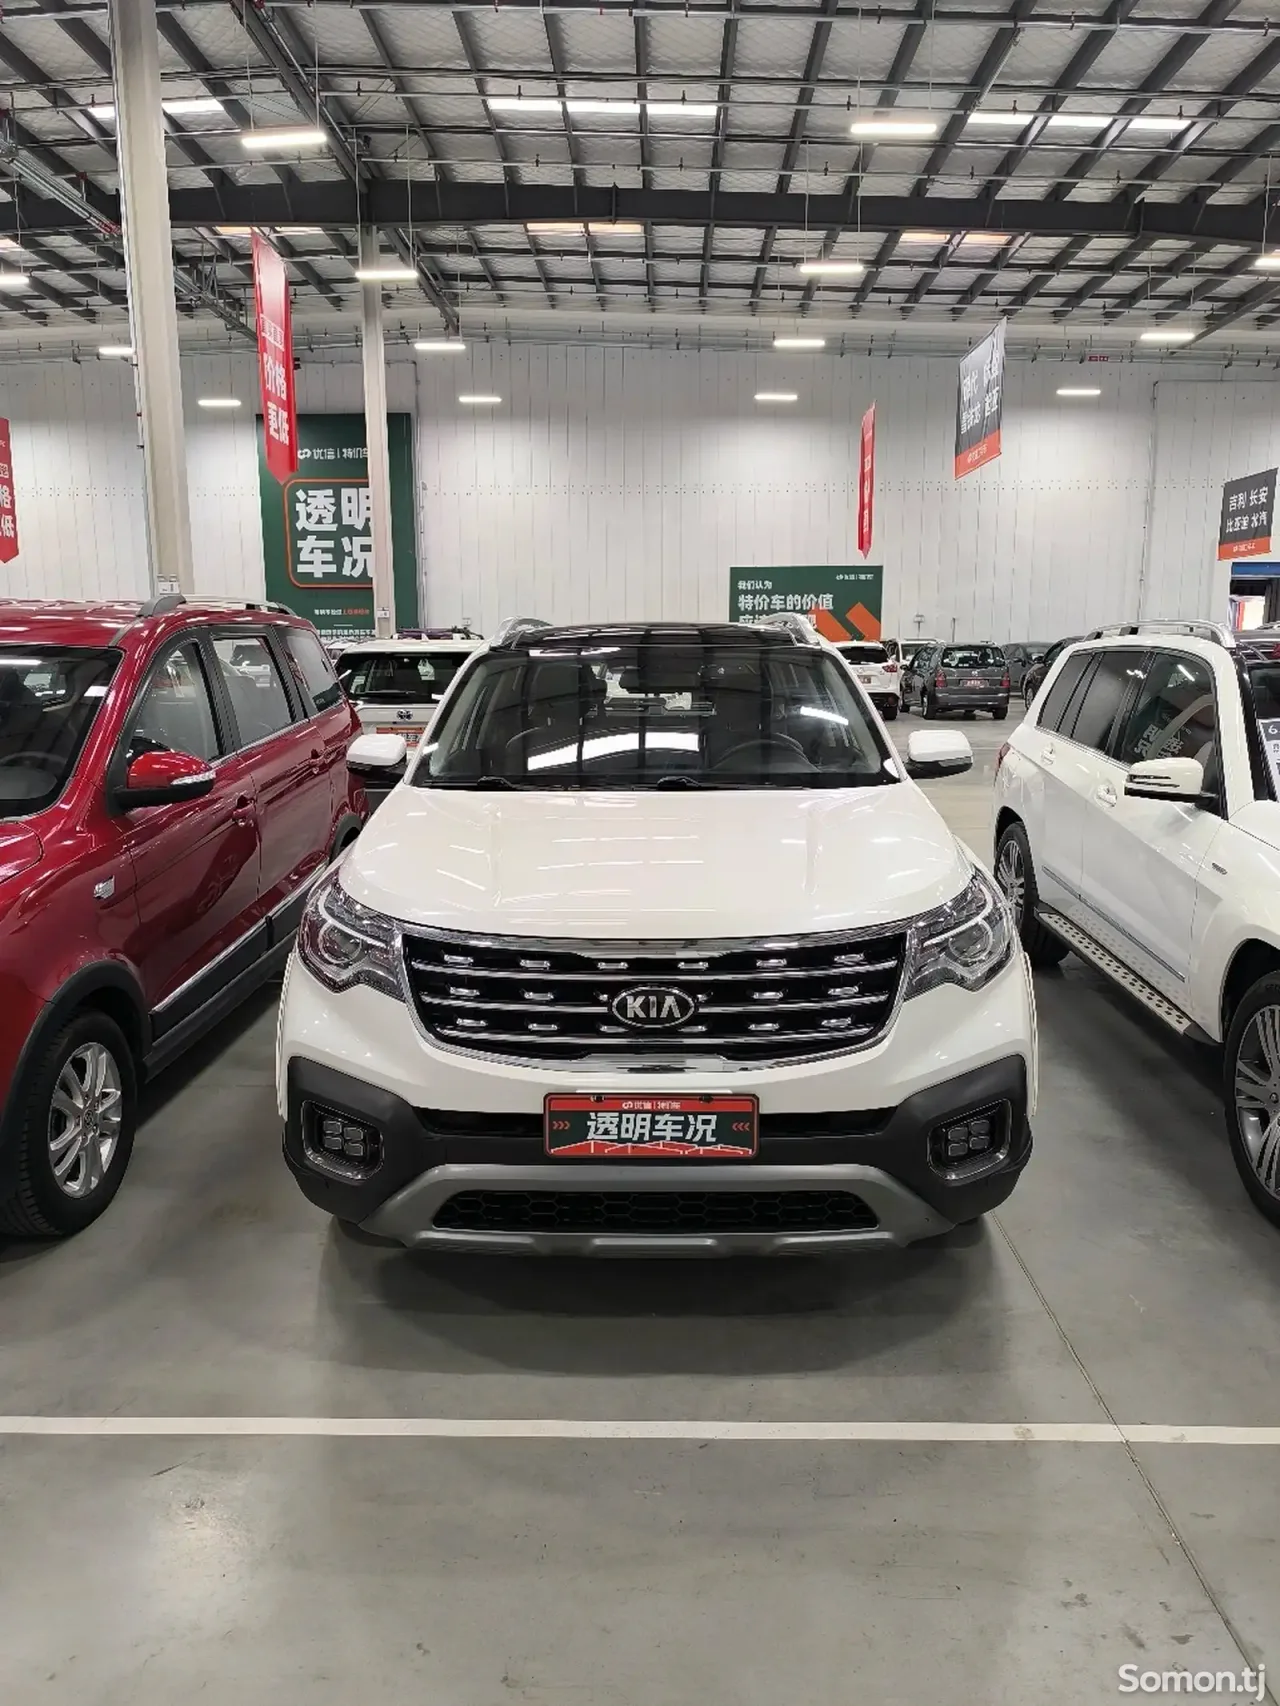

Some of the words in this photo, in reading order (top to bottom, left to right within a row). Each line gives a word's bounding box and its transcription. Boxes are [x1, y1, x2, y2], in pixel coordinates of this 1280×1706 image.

[295, 488, 373, 531] 透明
[1229, 491, 1247, 512] 吉利
[297, 535, 374, 578] 车况
[737, 580, 773, 590] 我们认为
[738, 593, 834, 611] 特价车的价值
[626, 995, 681, 1018] KIA
[586, 1112, 717, 1142] 透明车况
